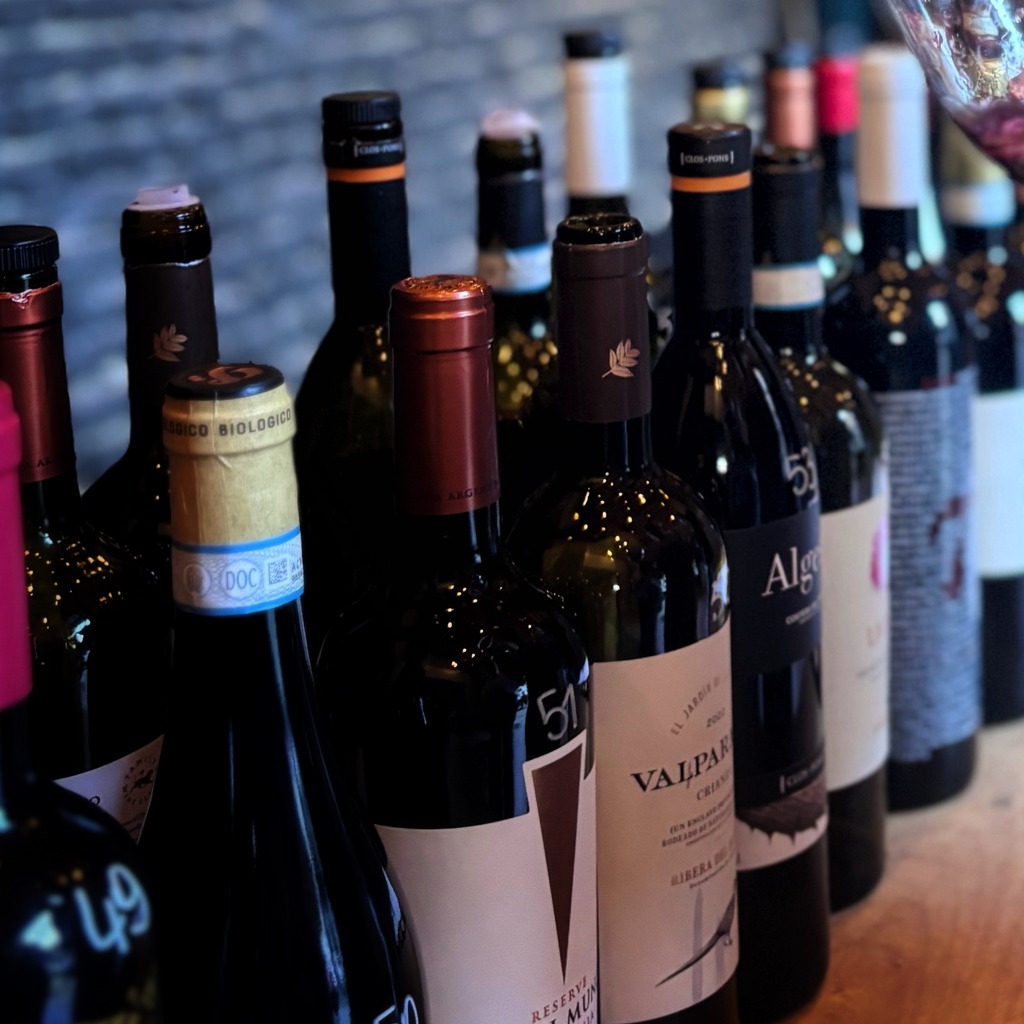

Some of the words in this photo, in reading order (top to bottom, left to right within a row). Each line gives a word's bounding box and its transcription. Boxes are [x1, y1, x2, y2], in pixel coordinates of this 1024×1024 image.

[219, 408, 291, 437] BIOLOGICO
[225, 567, 257, 591] DOC
[536, 682, 578, 741] 51
[630, 734, 733, 792] VALPAR
[670, 859, 712, 887] RIBERA
[73, 862, 151, 954] 49
